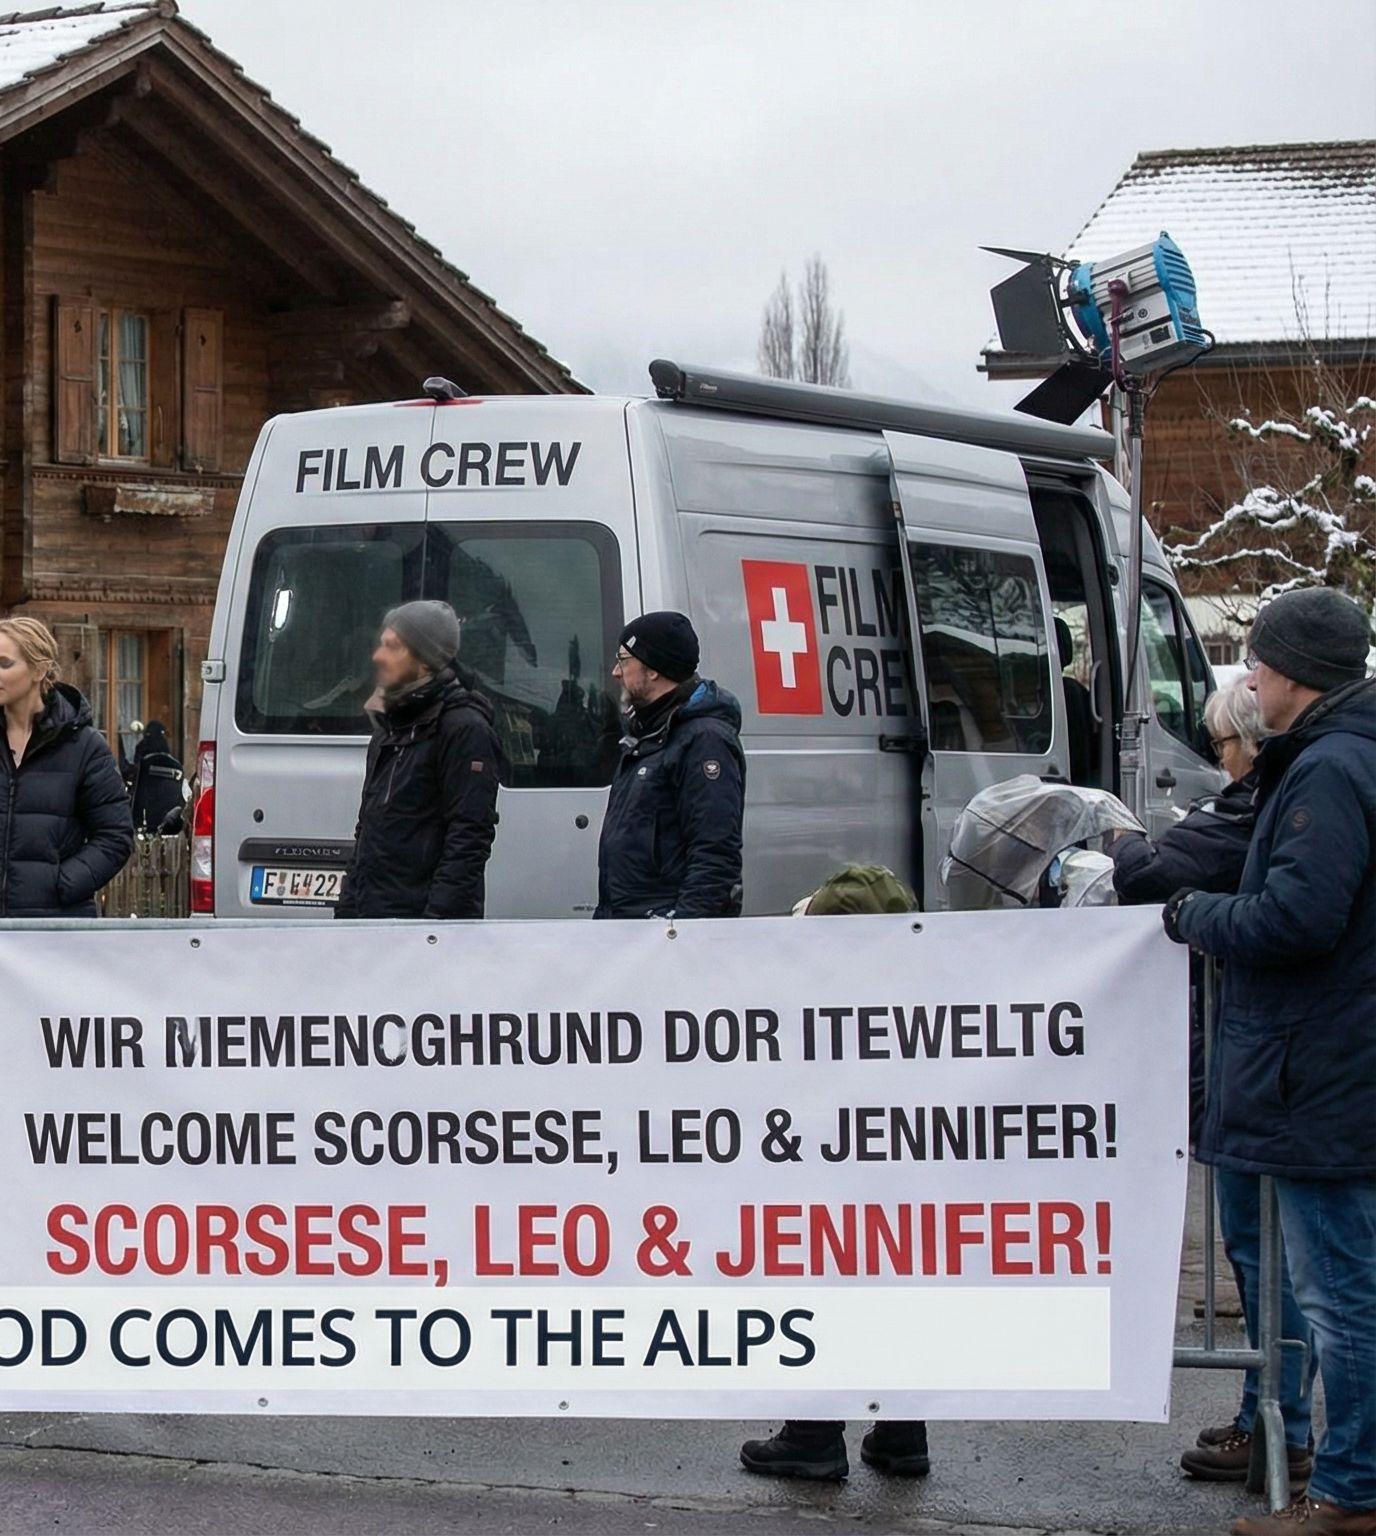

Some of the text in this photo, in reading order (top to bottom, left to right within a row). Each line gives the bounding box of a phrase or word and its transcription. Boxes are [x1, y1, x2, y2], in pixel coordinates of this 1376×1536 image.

[295, 441, 582, 493] FILM CREW
[814, 565, 908, 638] FILM
[40, 1016, 145, 1068] WIR
[664, 1008, 782, 1063] DOR
[802, 1001, 1085, 1061] ITEWELTG
[23, 1103, 1117, 1175] WELCOME SCORSESE, LEO & JENNIFER!
[47, 1202, 1111, 1287] SCORSESE, LEO & JENNIFER!
